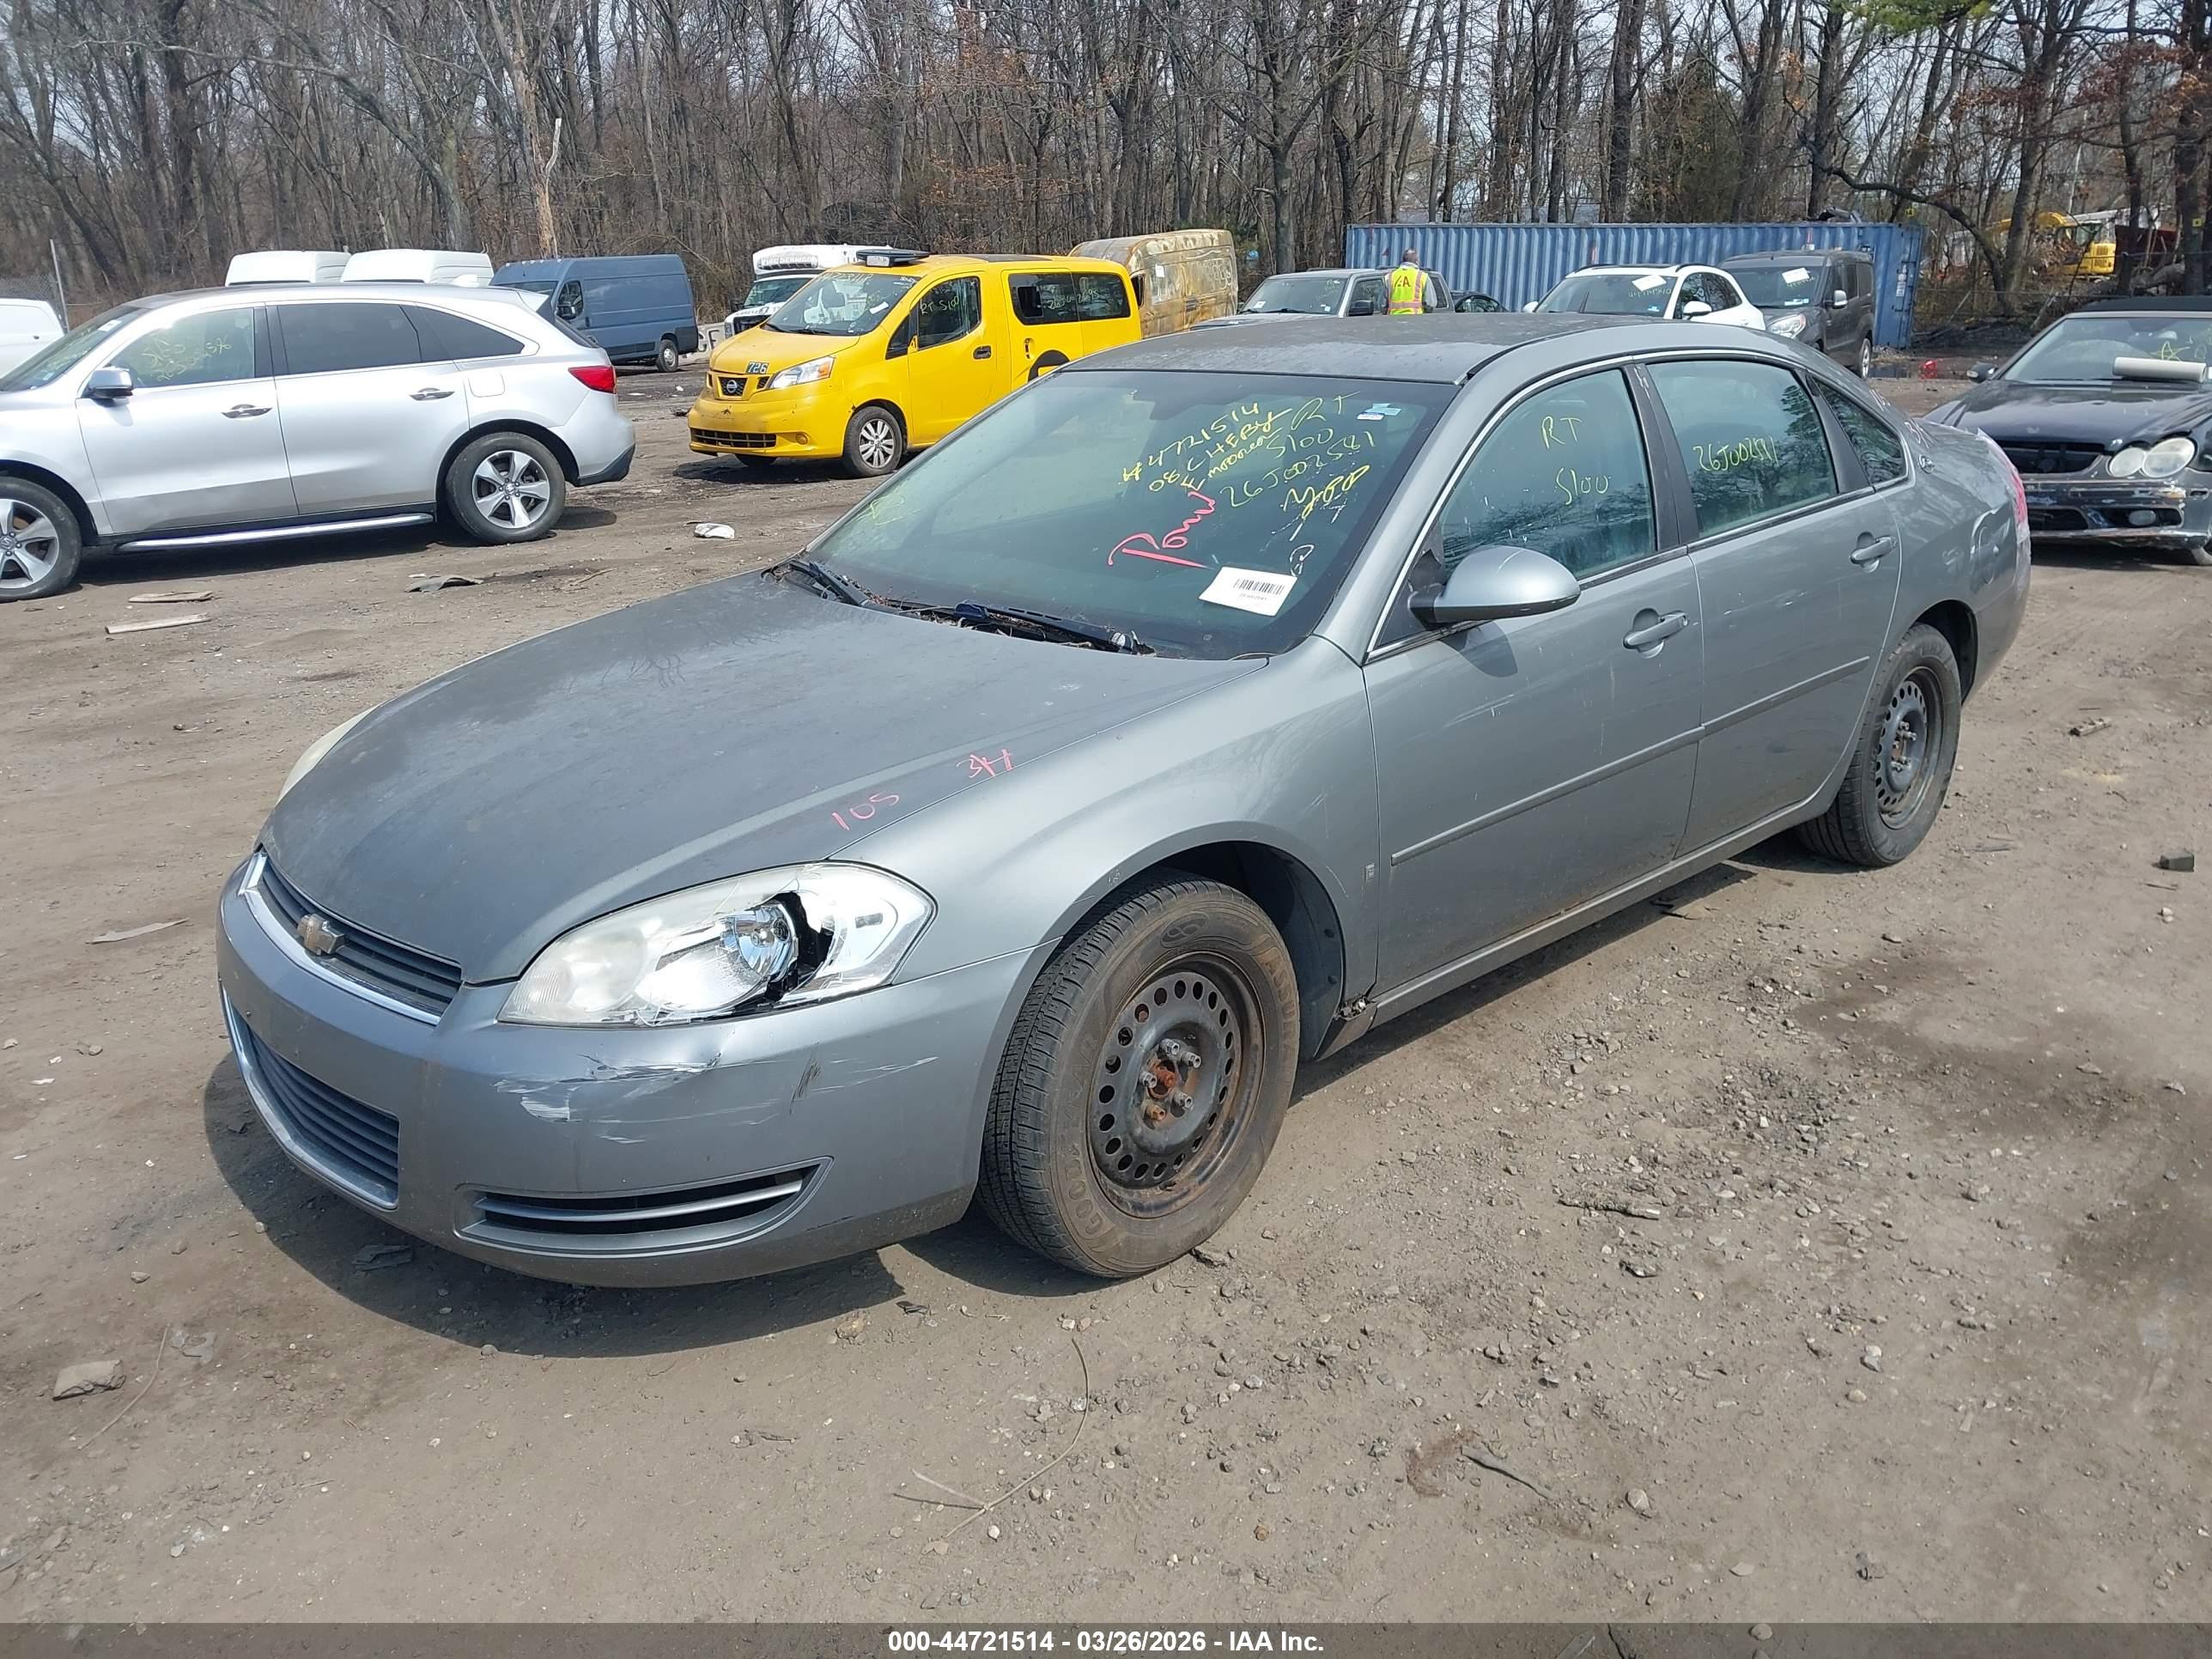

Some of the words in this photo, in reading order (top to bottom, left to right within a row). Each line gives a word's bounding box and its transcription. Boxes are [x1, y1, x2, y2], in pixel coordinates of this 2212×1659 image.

[747, 362, 768, 374] 726
[1540, 416, 1583, 449] RT
[1554, 467, 1611, 505] S100
